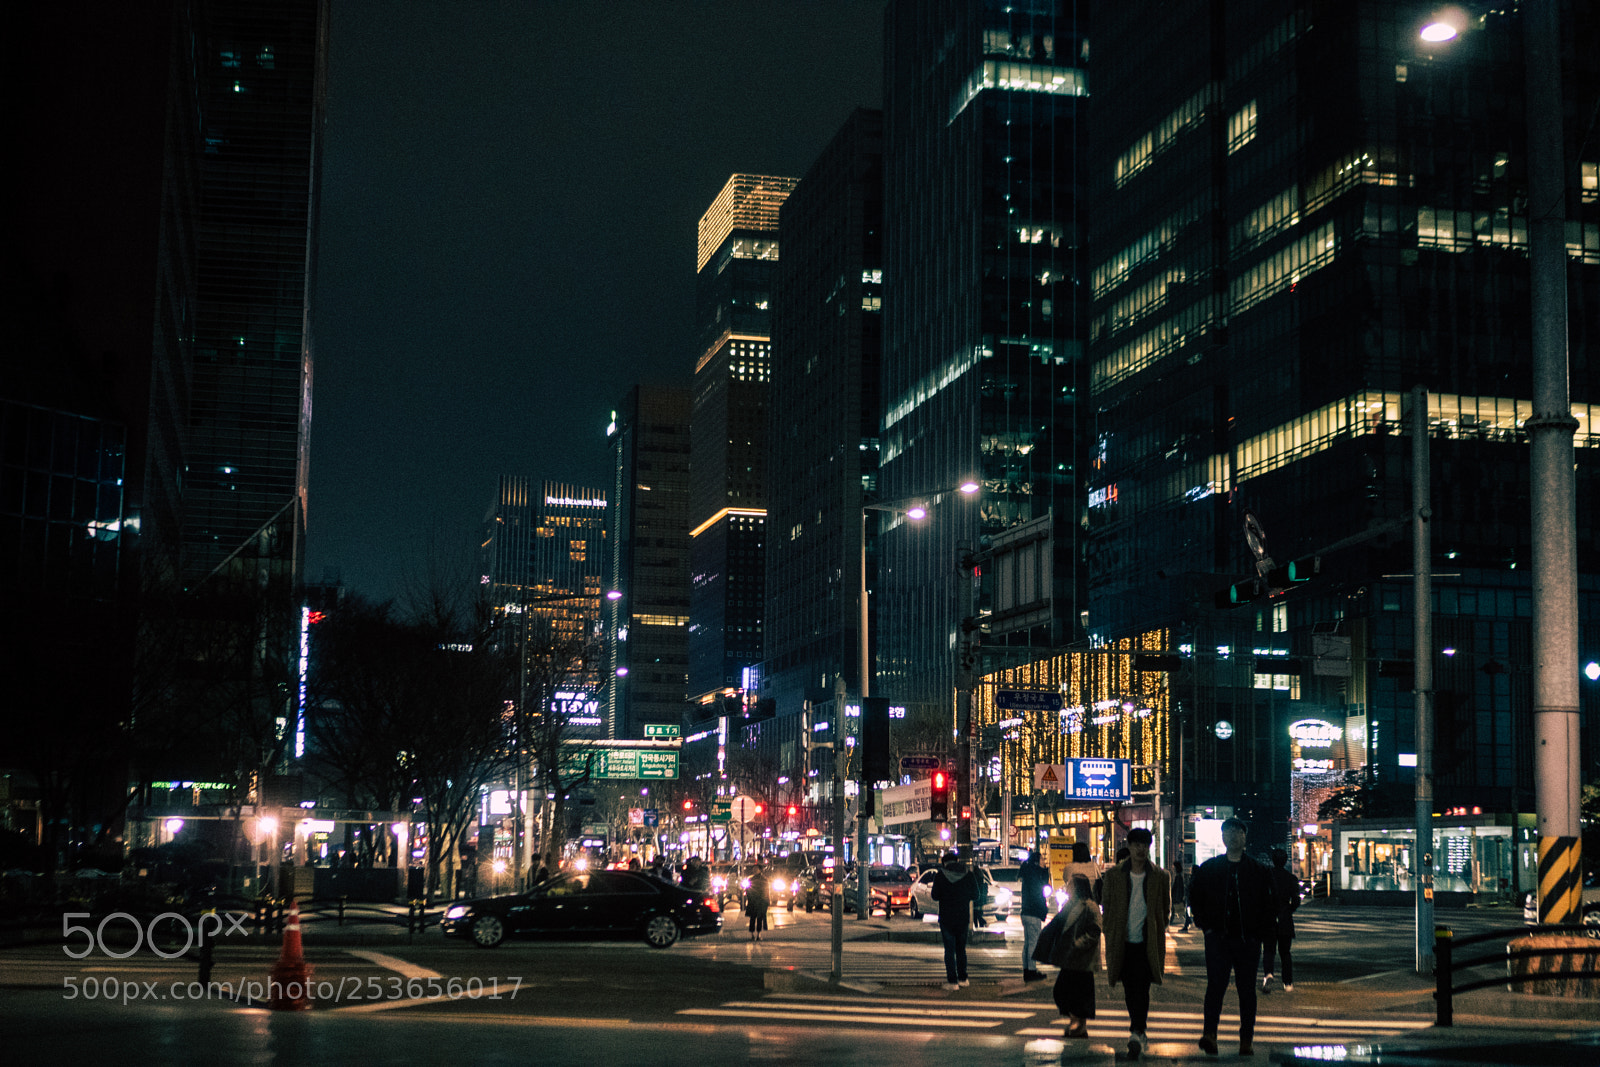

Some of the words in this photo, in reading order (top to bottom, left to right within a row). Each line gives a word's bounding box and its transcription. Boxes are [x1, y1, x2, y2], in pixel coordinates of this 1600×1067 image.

[1014, 692, 1046, 703] 우정국로
[641, 753, 676, 763] 안국동사거리
[1076, 787, 1120, 798] 중앙차로버스전용
